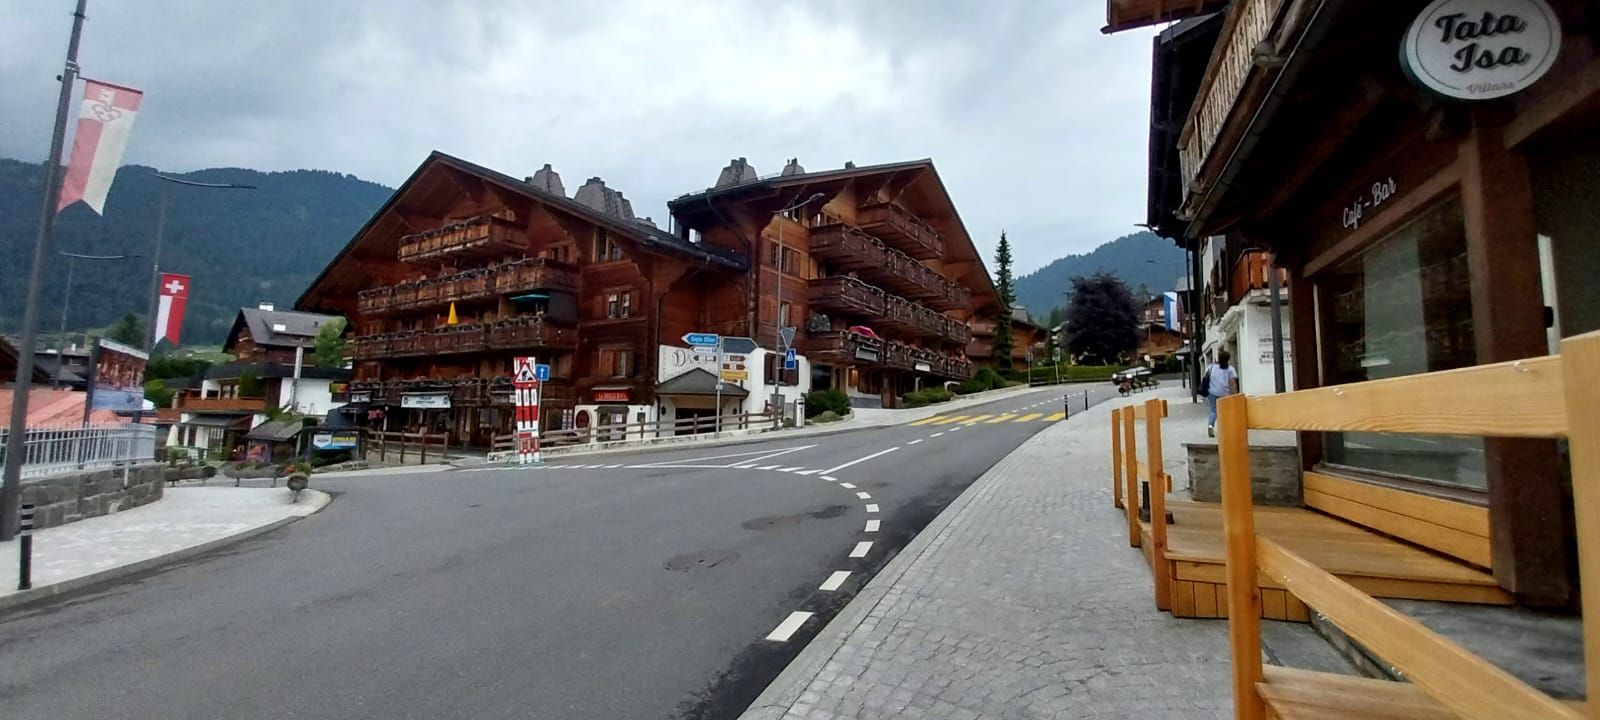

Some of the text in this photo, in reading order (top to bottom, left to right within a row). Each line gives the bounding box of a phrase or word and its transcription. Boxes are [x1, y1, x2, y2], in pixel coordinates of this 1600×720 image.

[1435, 11, 1528, 43] Tata
[1450, 43, 1531, 73] Isa
[1466, 81, 1514, 94] Villars
[1343, 196, 1362, 230] Café
[1372, 177, 1397, 207] Bar
